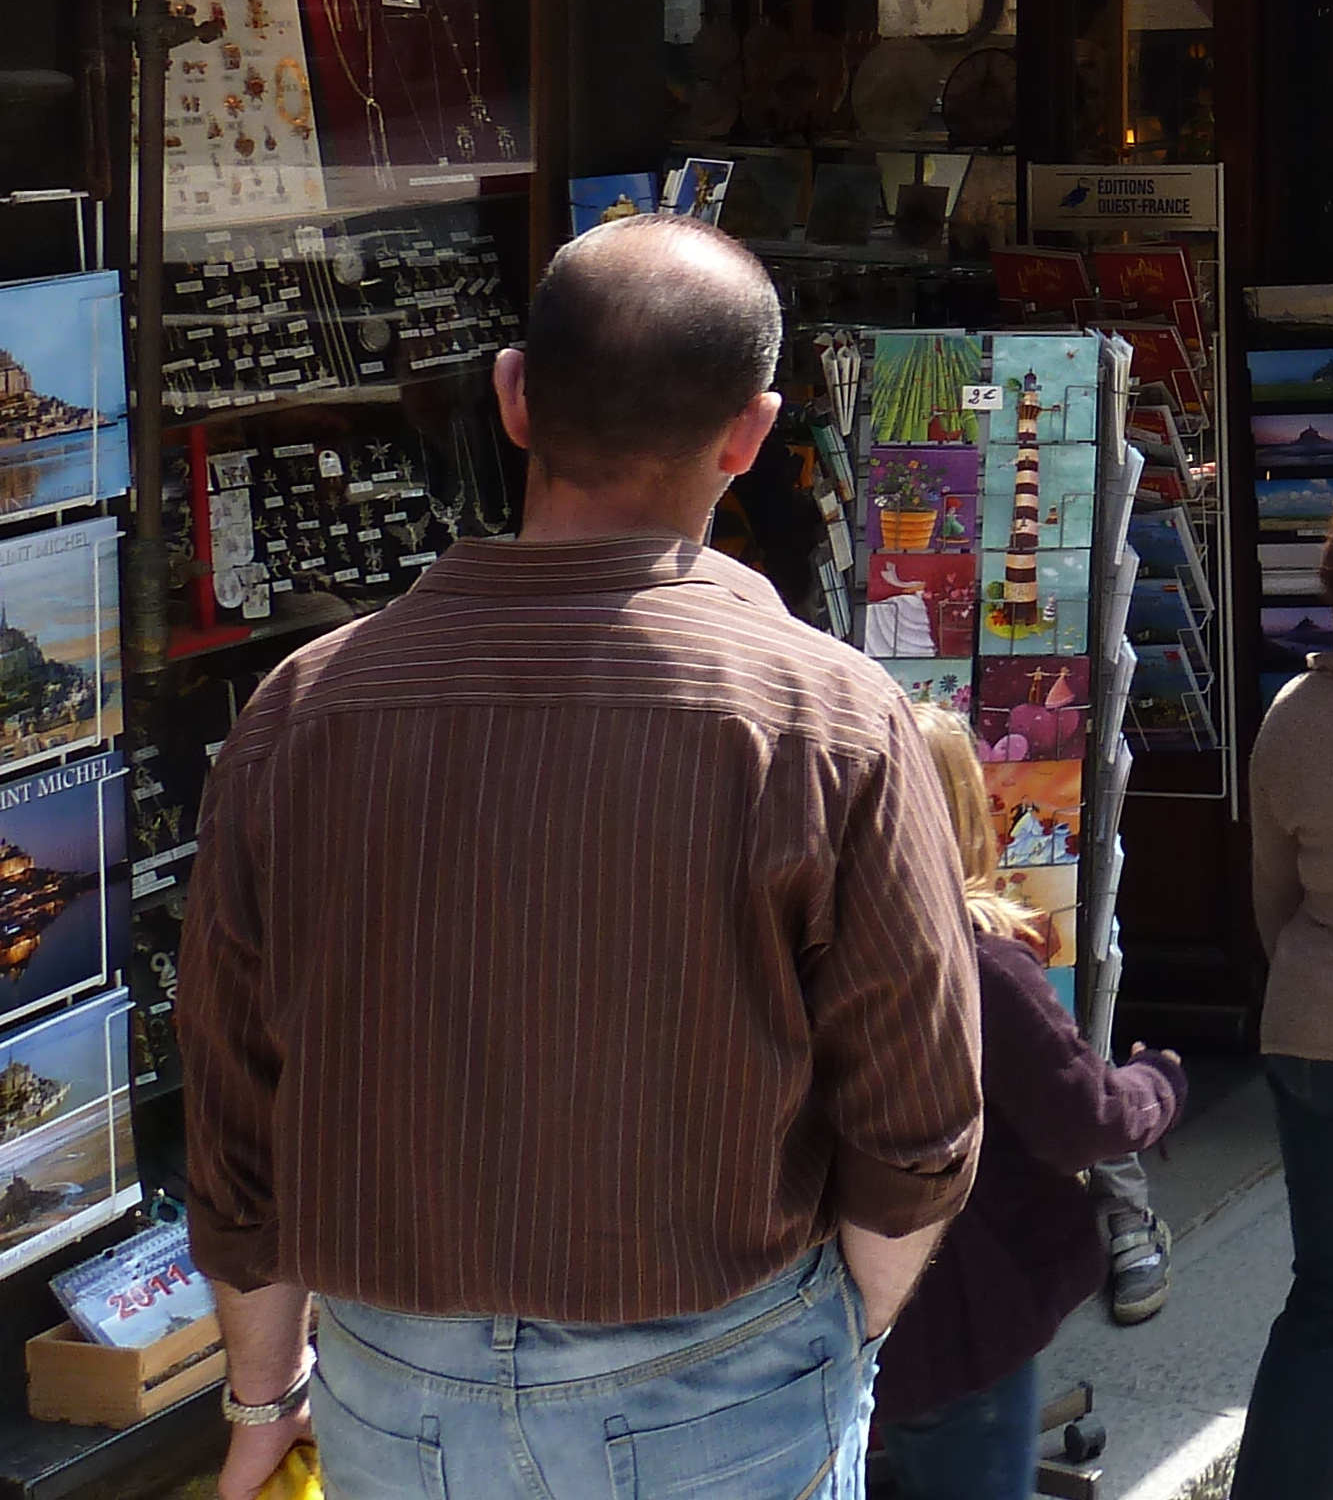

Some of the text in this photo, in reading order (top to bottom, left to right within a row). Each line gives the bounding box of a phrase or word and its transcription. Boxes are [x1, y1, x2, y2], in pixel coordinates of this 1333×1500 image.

[1097, 177, 1155, 195] ÉDITIONS
[1098, 198, 1190, 214] OUEST-FRANCE
[37, 758, 112, 798] MICHEL
[107, 1263, 192, 1321] 2011
